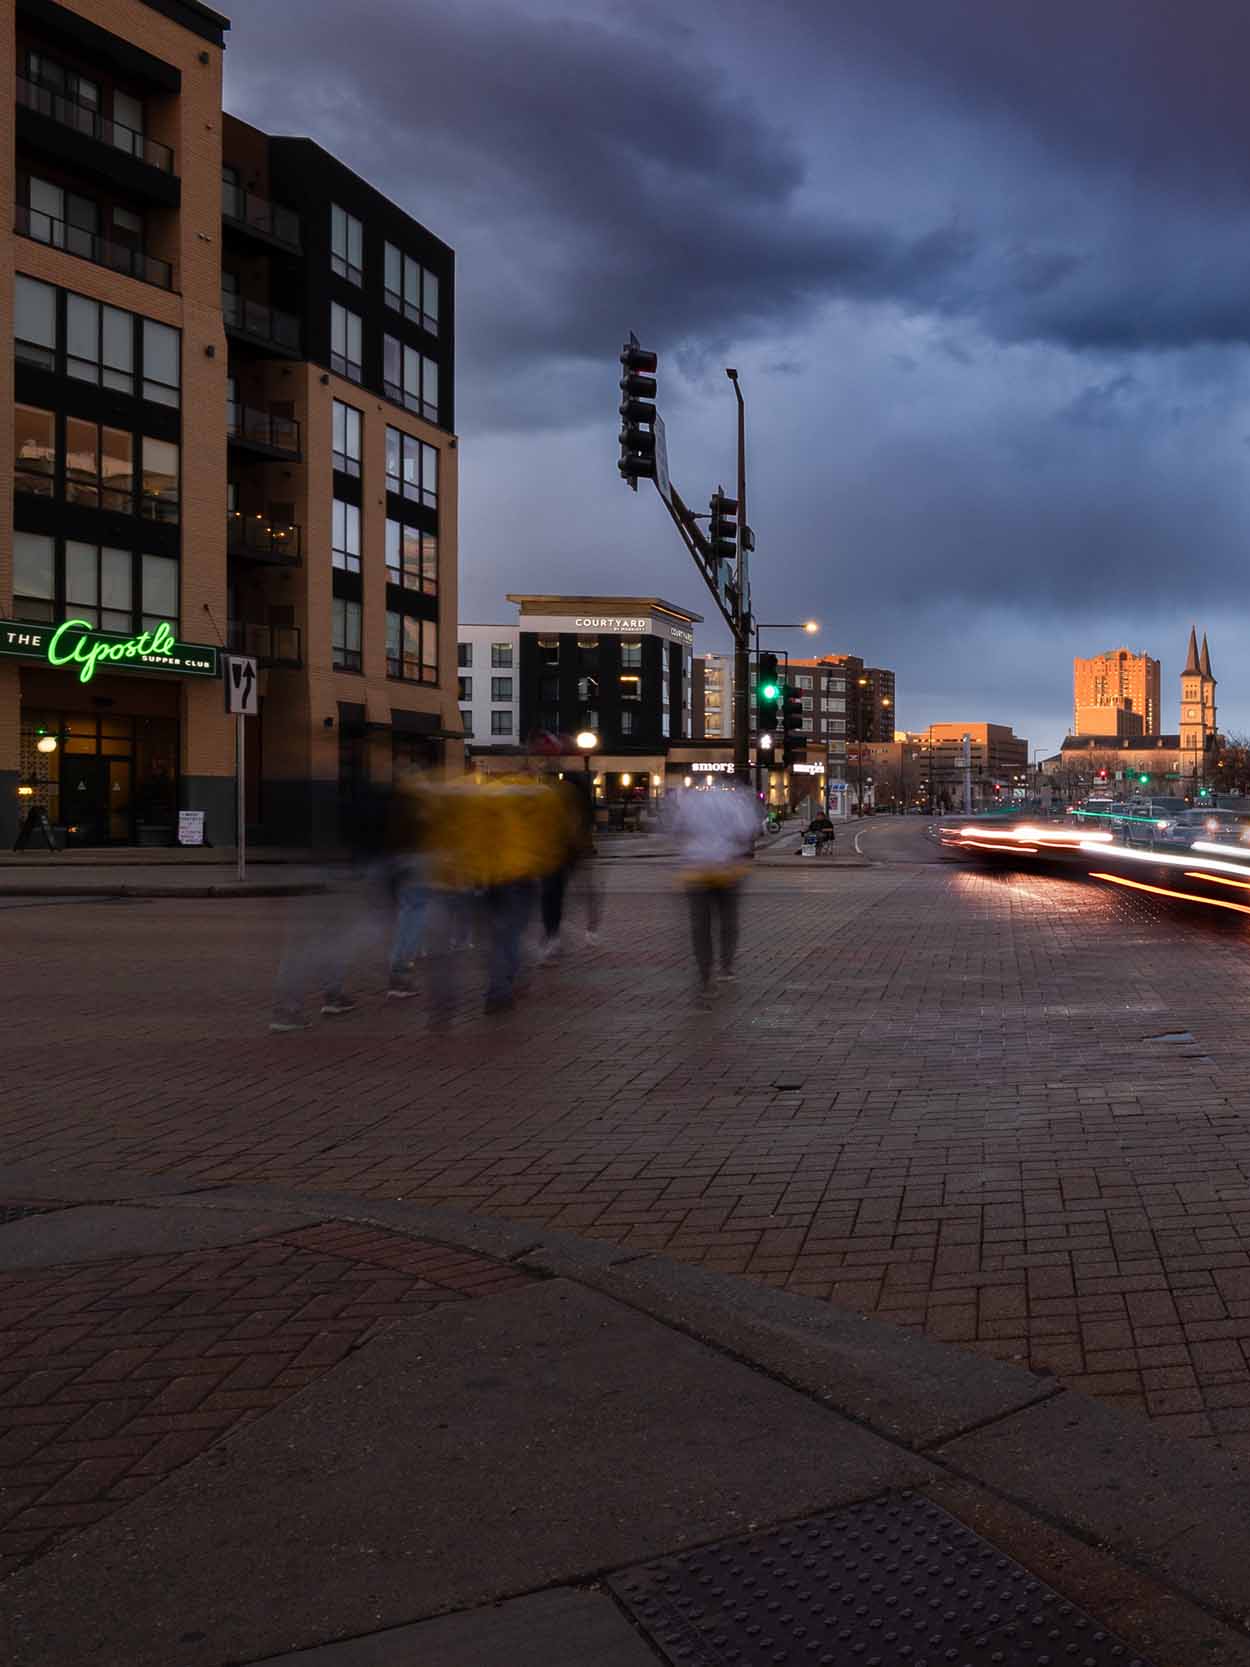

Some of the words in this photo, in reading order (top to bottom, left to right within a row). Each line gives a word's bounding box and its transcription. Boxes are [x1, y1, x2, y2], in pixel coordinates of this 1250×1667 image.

[575, 618, 646, 628] COURTYARD
[7, 632, 42, 647] THE
[142, 655, 181, 665] SUPPER
[185, 659, 210, 668] CLUB
